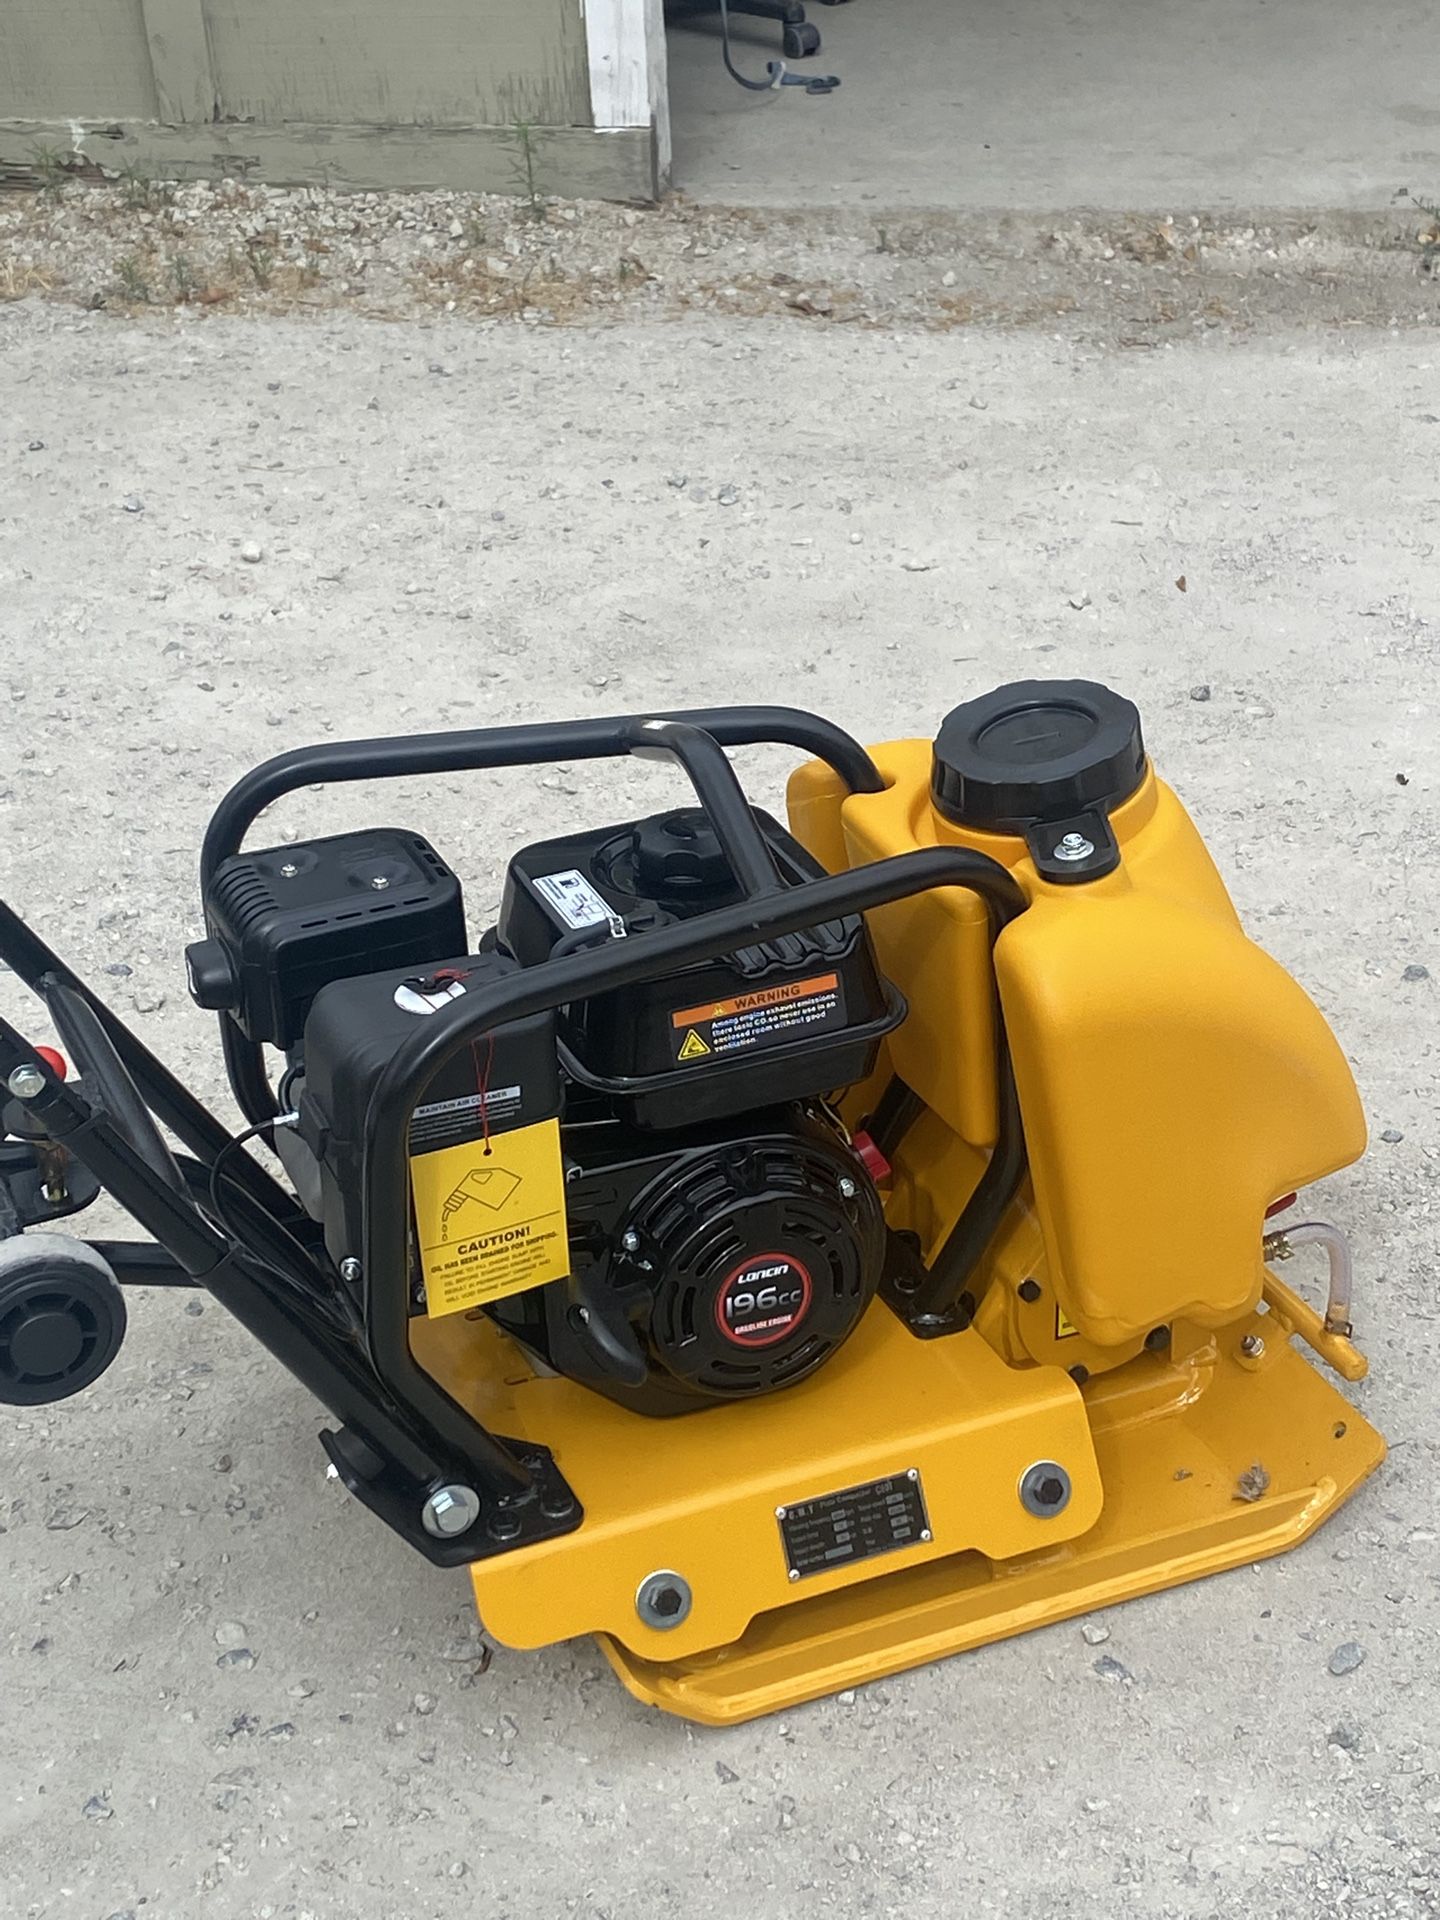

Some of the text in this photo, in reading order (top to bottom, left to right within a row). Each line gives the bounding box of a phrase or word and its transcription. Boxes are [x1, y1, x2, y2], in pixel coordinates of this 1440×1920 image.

[735, 985, 800, 1010] WARNING
[740, 1009, 765, 1022] engine
[766, 1001, 796, 1015] exhaust
[712, 1026, 733, 1037] there
[779, 1009, 801, 1020] never
[802, 1005, 817, 1015] use
[713, 1010, 827, 1045] enclosed room without good
[418, 1090, 507, 1115] MAINTAIN AIR CLANER
[457, 1225, 531, 1255] CAUTION!
[431, 1263, 443, 1274] OIL
[445, 1260, 459, 1270] HAS
[460, 1254, 479, 1266] BEEN
[480, 1247, 510, 1260] DRAINED
[511, 1241, 525, 1252] FOR
